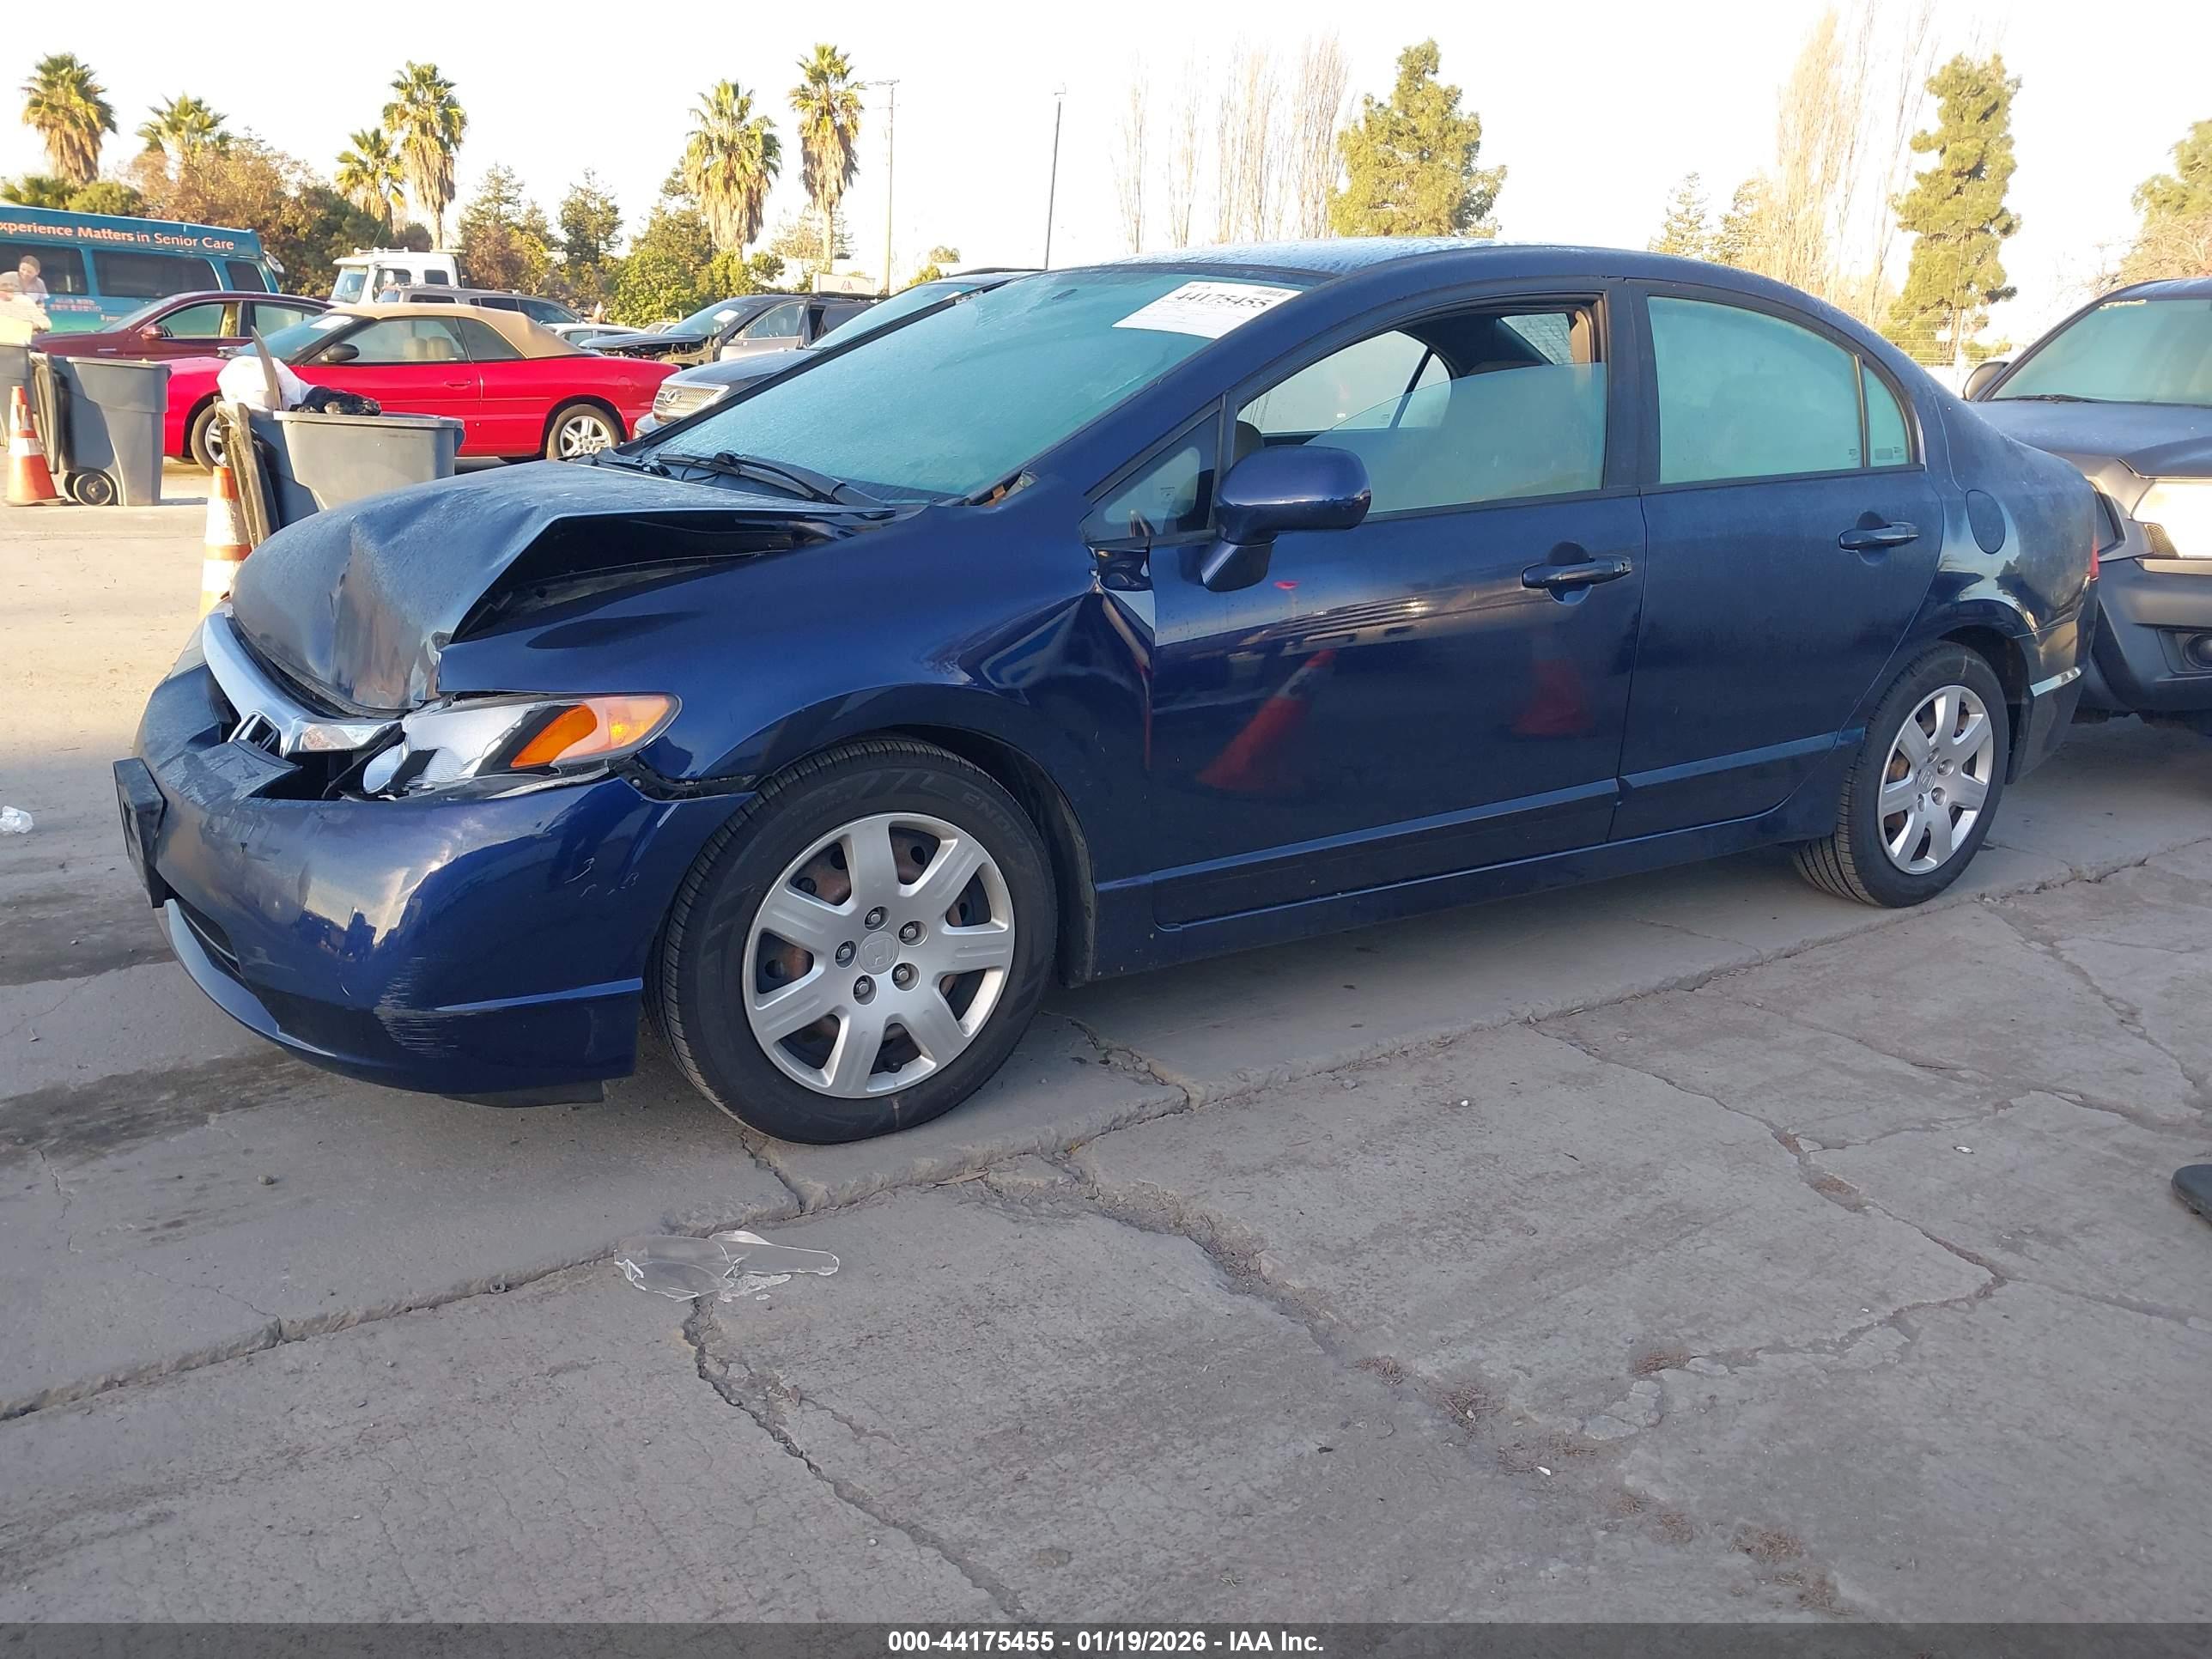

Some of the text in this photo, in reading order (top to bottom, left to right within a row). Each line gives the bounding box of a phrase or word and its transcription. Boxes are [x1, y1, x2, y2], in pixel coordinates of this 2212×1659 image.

[0, 222, 234, 250] xperience Matters in Senior Care
[1175, 292, 1273, 308] 44175455
